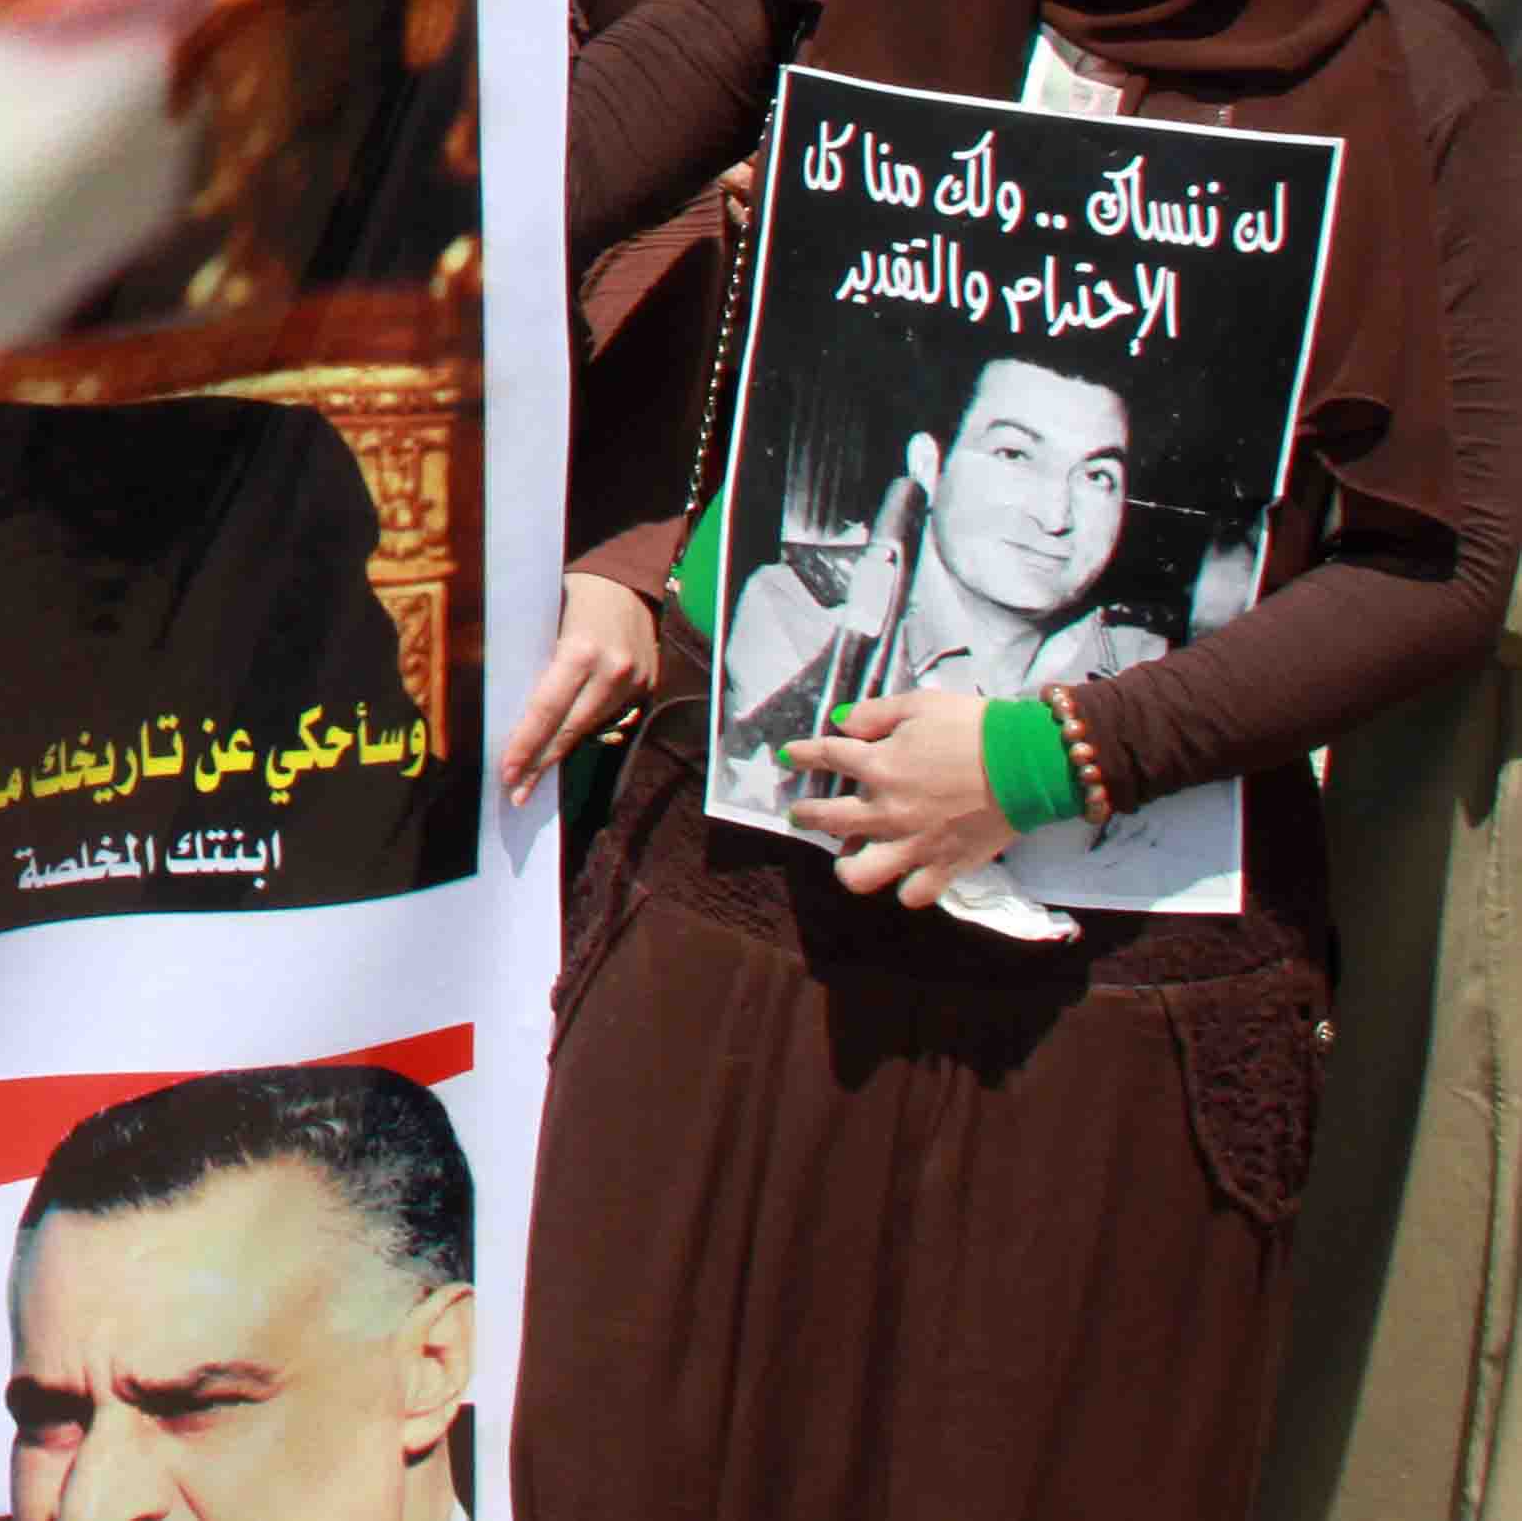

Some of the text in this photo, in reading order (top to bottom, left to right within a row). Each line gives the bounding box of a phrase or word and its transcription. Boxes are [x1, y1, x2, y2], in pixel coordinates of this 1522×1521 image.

[803, 120, 857, 192] كل
[863, 131, 924, 208] منا
[934, 130, 1024, 233] ولك
[1085, 154, 1220, 248] ننساك
[1232, 181, 1289, 253] لن
[834, 233, 991, 323] والتقدير
[30, 714, 186, 805] تاريخك
[194, 718, 255, 794] عن
[265, 701, 428, 806] وسأحكي
[14, 828, 282, 890] ابنتك المخلصة
